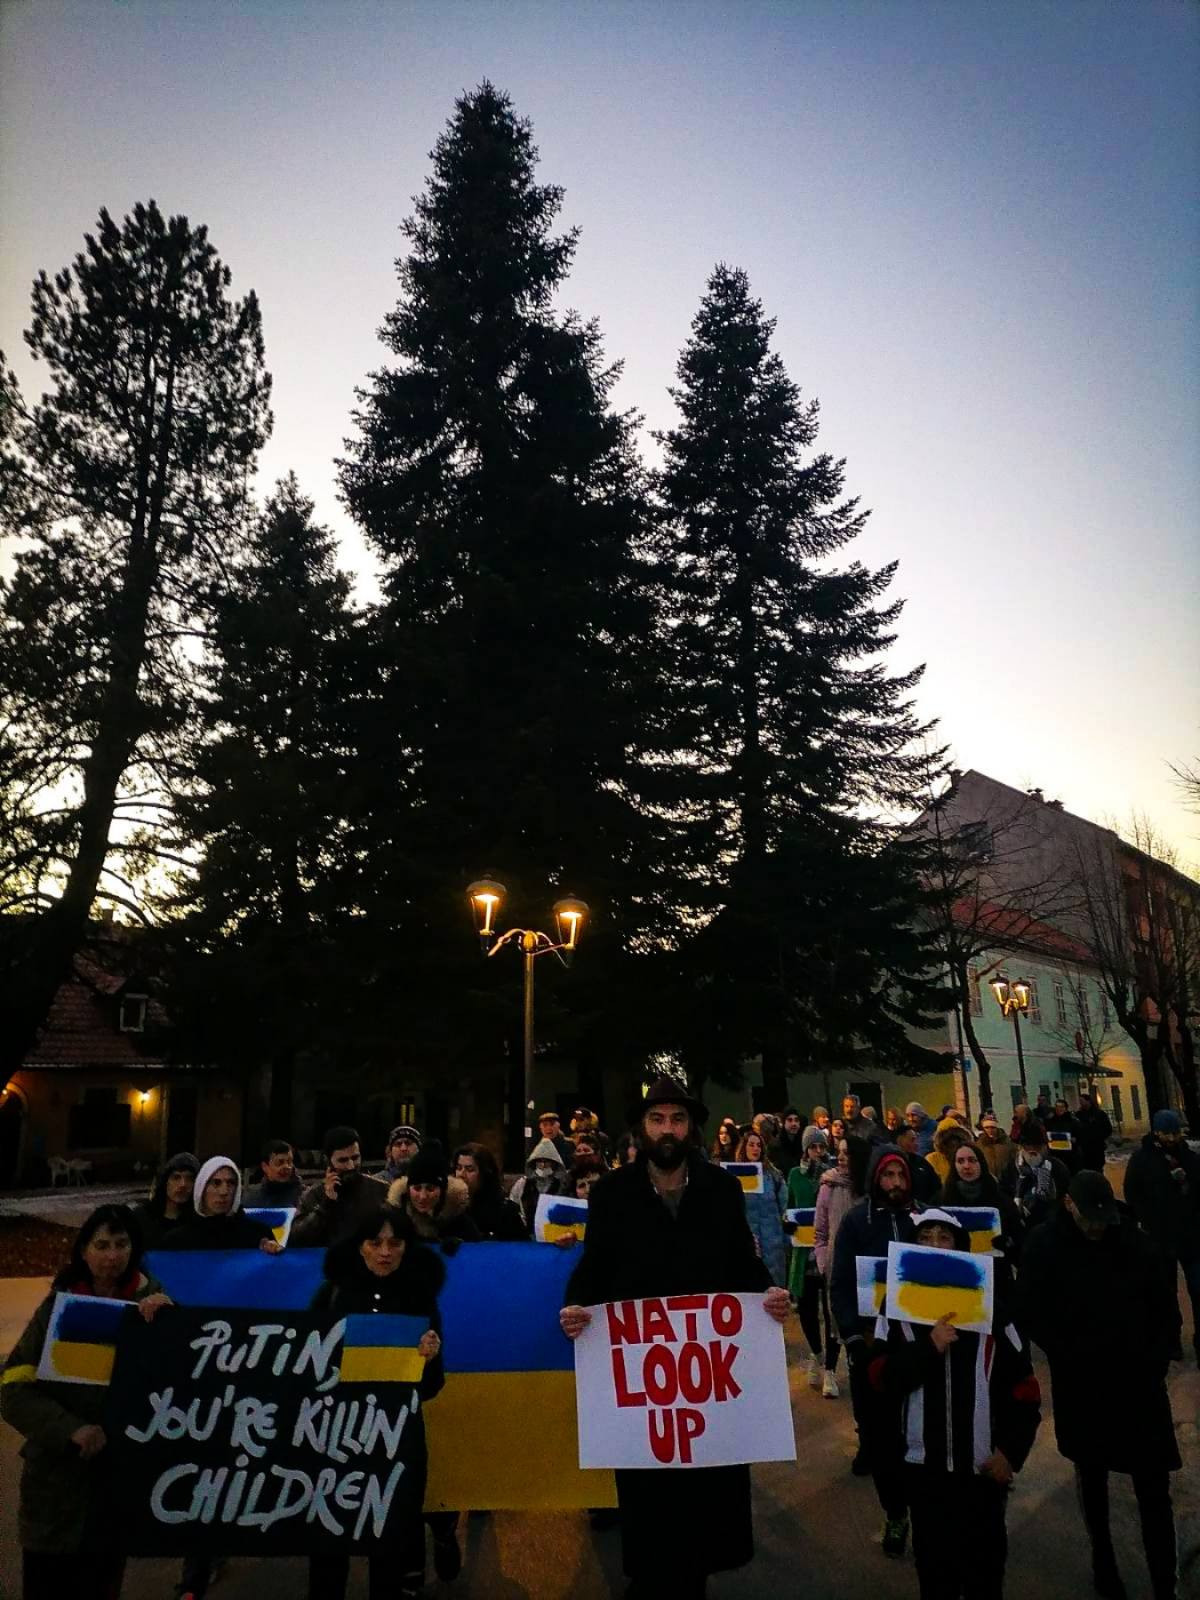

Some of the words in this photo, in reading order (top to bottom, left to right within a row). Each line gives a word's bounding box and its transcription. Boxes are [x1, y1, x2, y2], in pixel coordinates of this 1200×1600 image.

[606, 1294, 742, 1345] NATO
[610, 1340, 742, 1408] LOOK
[648, 1407, 706, 1463] UP
